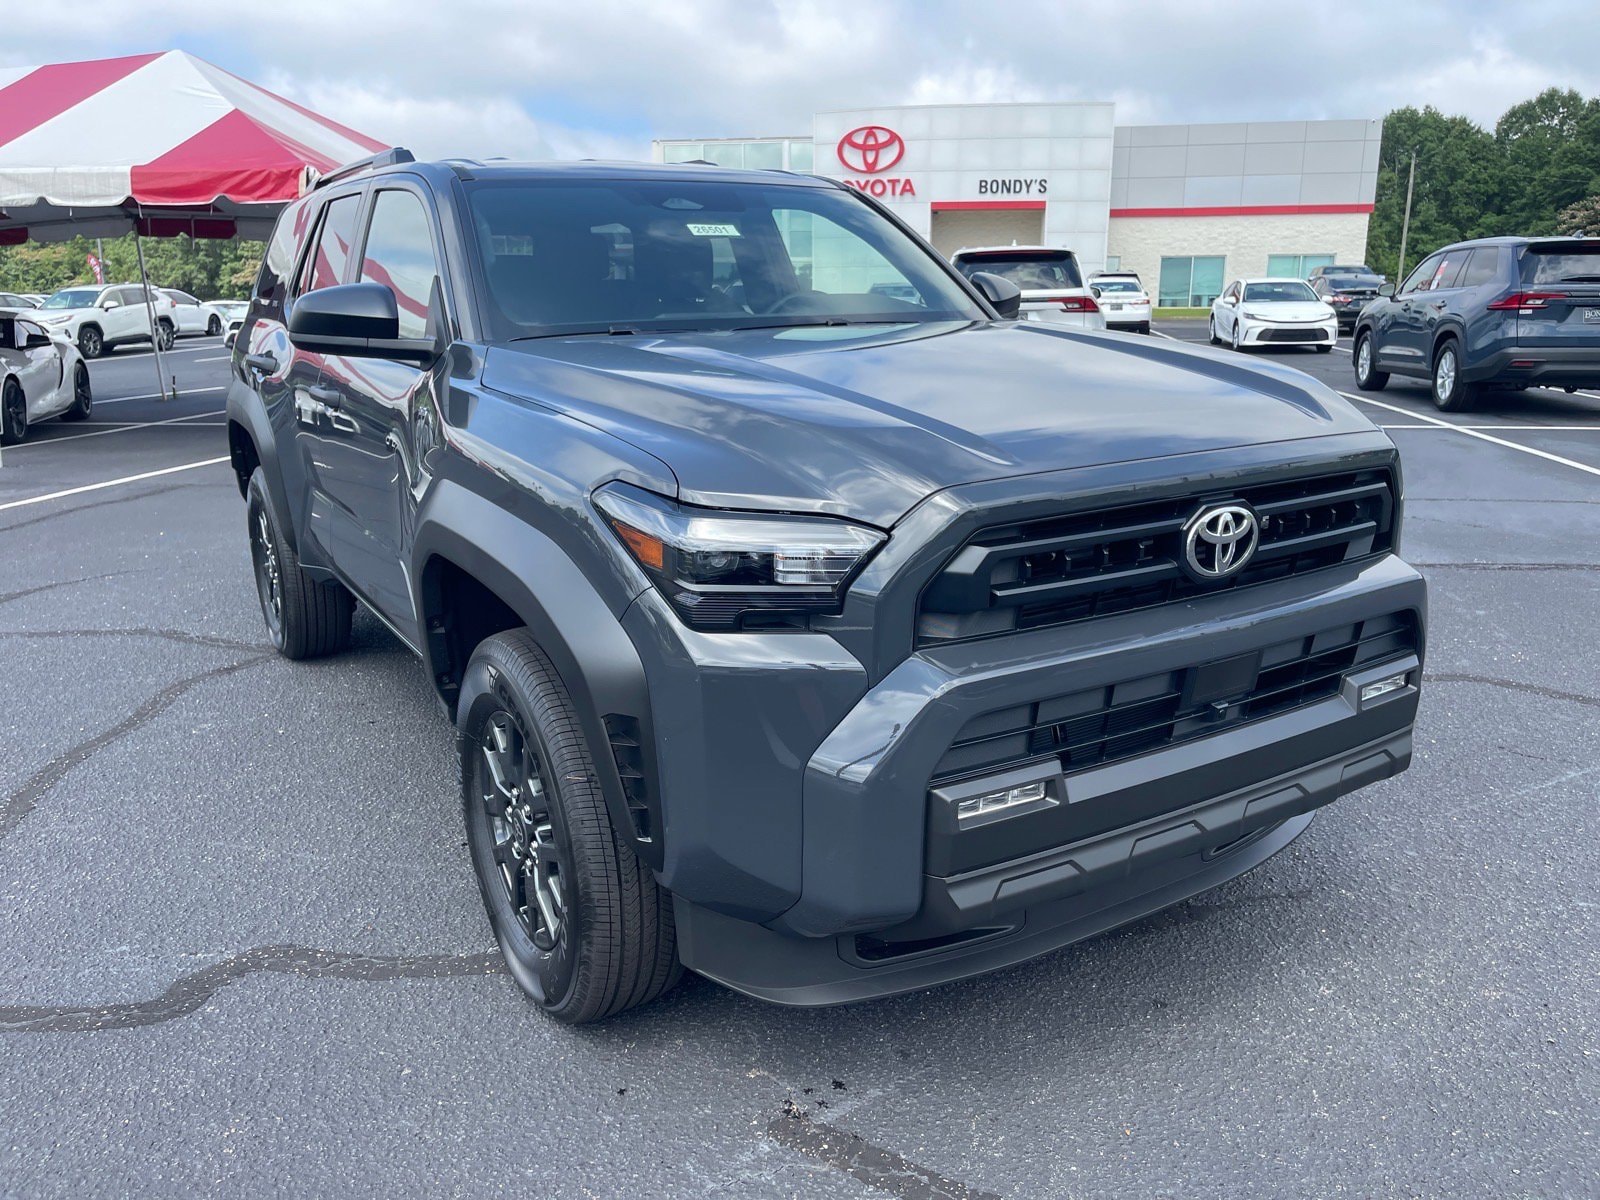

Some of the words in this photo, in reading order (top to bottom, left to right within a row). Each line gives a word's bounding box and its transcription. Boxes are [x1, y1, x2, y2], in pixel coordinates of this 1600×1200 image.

[843, 179, 916, 198] YOTA
[979, 179, 1048, 194] BONDY'S
[693, 226, 729, 234] 26501
